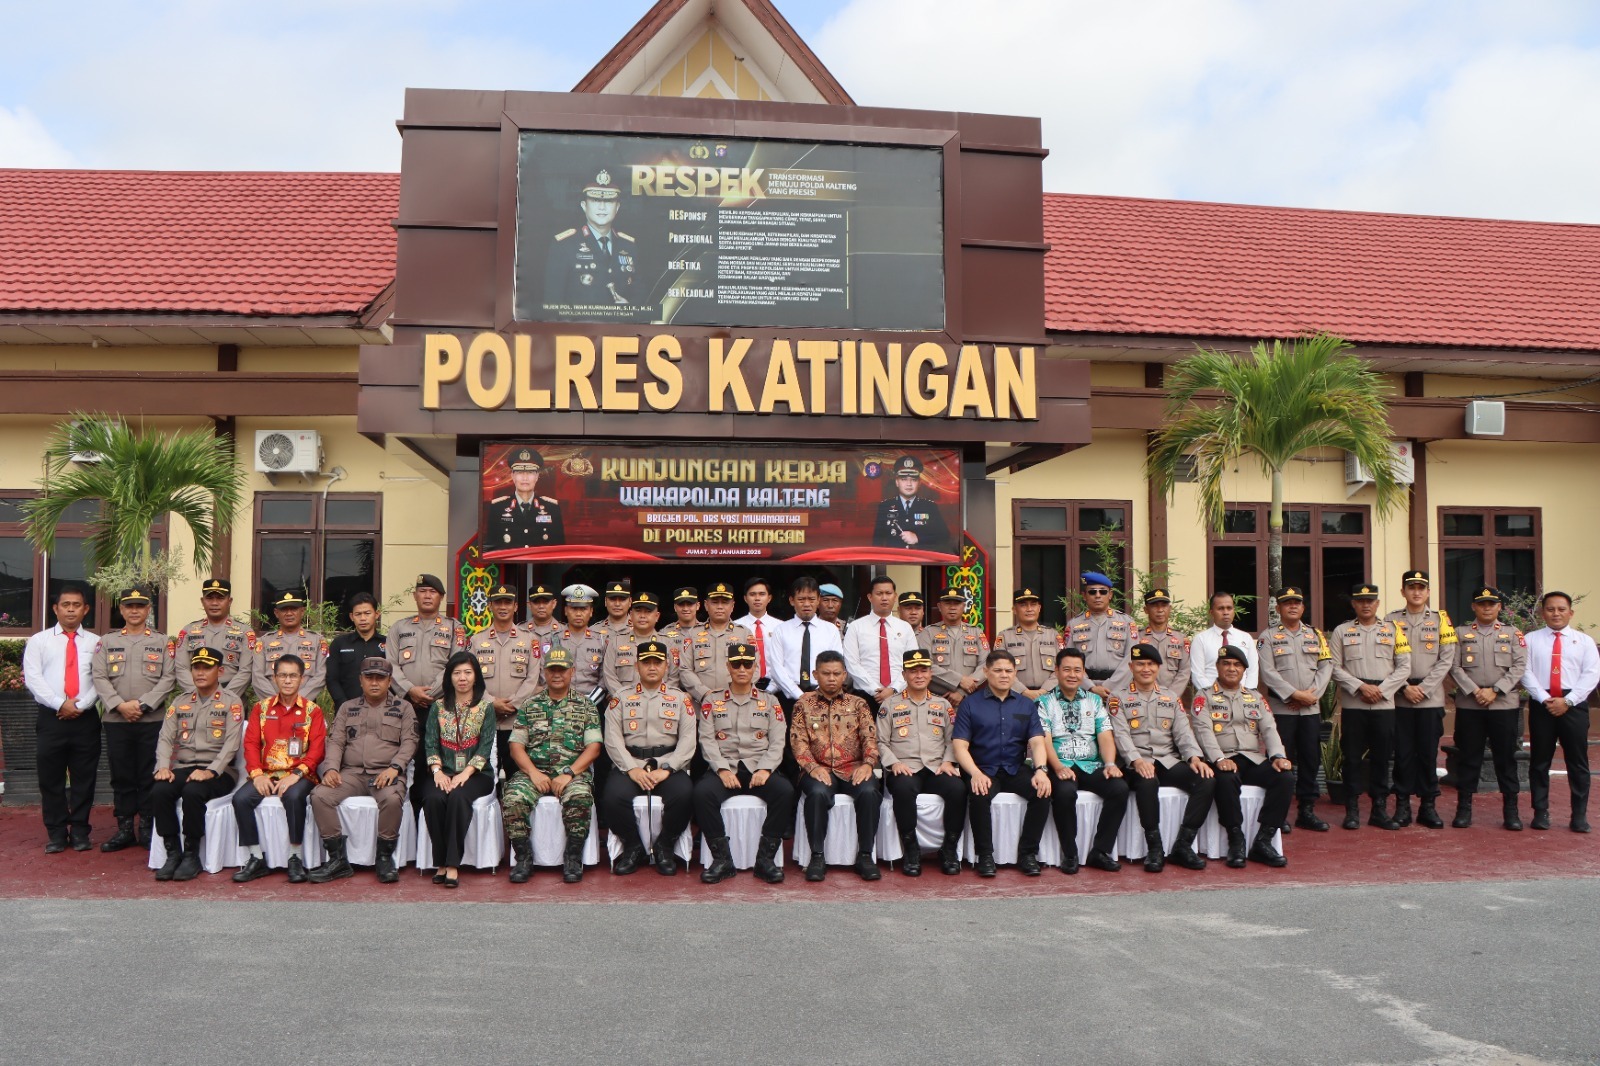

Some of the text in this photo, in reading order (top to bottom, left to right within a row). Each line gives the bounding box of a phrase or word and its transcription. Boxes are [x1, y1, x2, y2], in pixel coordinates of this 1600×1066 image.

[632, 165, 766, 199] RESPEK
[768, 173, 825, 182] TRANSFORMASI
[788, 188, 817, 196] PRESISI
[825, 183, 857, 191] KALTENG
[423, 332, 1038, 421] POLRES KATINGAN
[601, 458, 847, 483] KUNJUNGAN KERJA
[620, 486, 830, 509] WAKAPOLDA KALTENG
[646, 513, 681, 523] BRIGJEN
[683, 514, 700, 523] POL.
[720, 514, 740, 524] YOSI
[742, 514, 801, 524] MUHAMARTHA
[643, 528, 806, 544] DI POLRES KATINGAN
